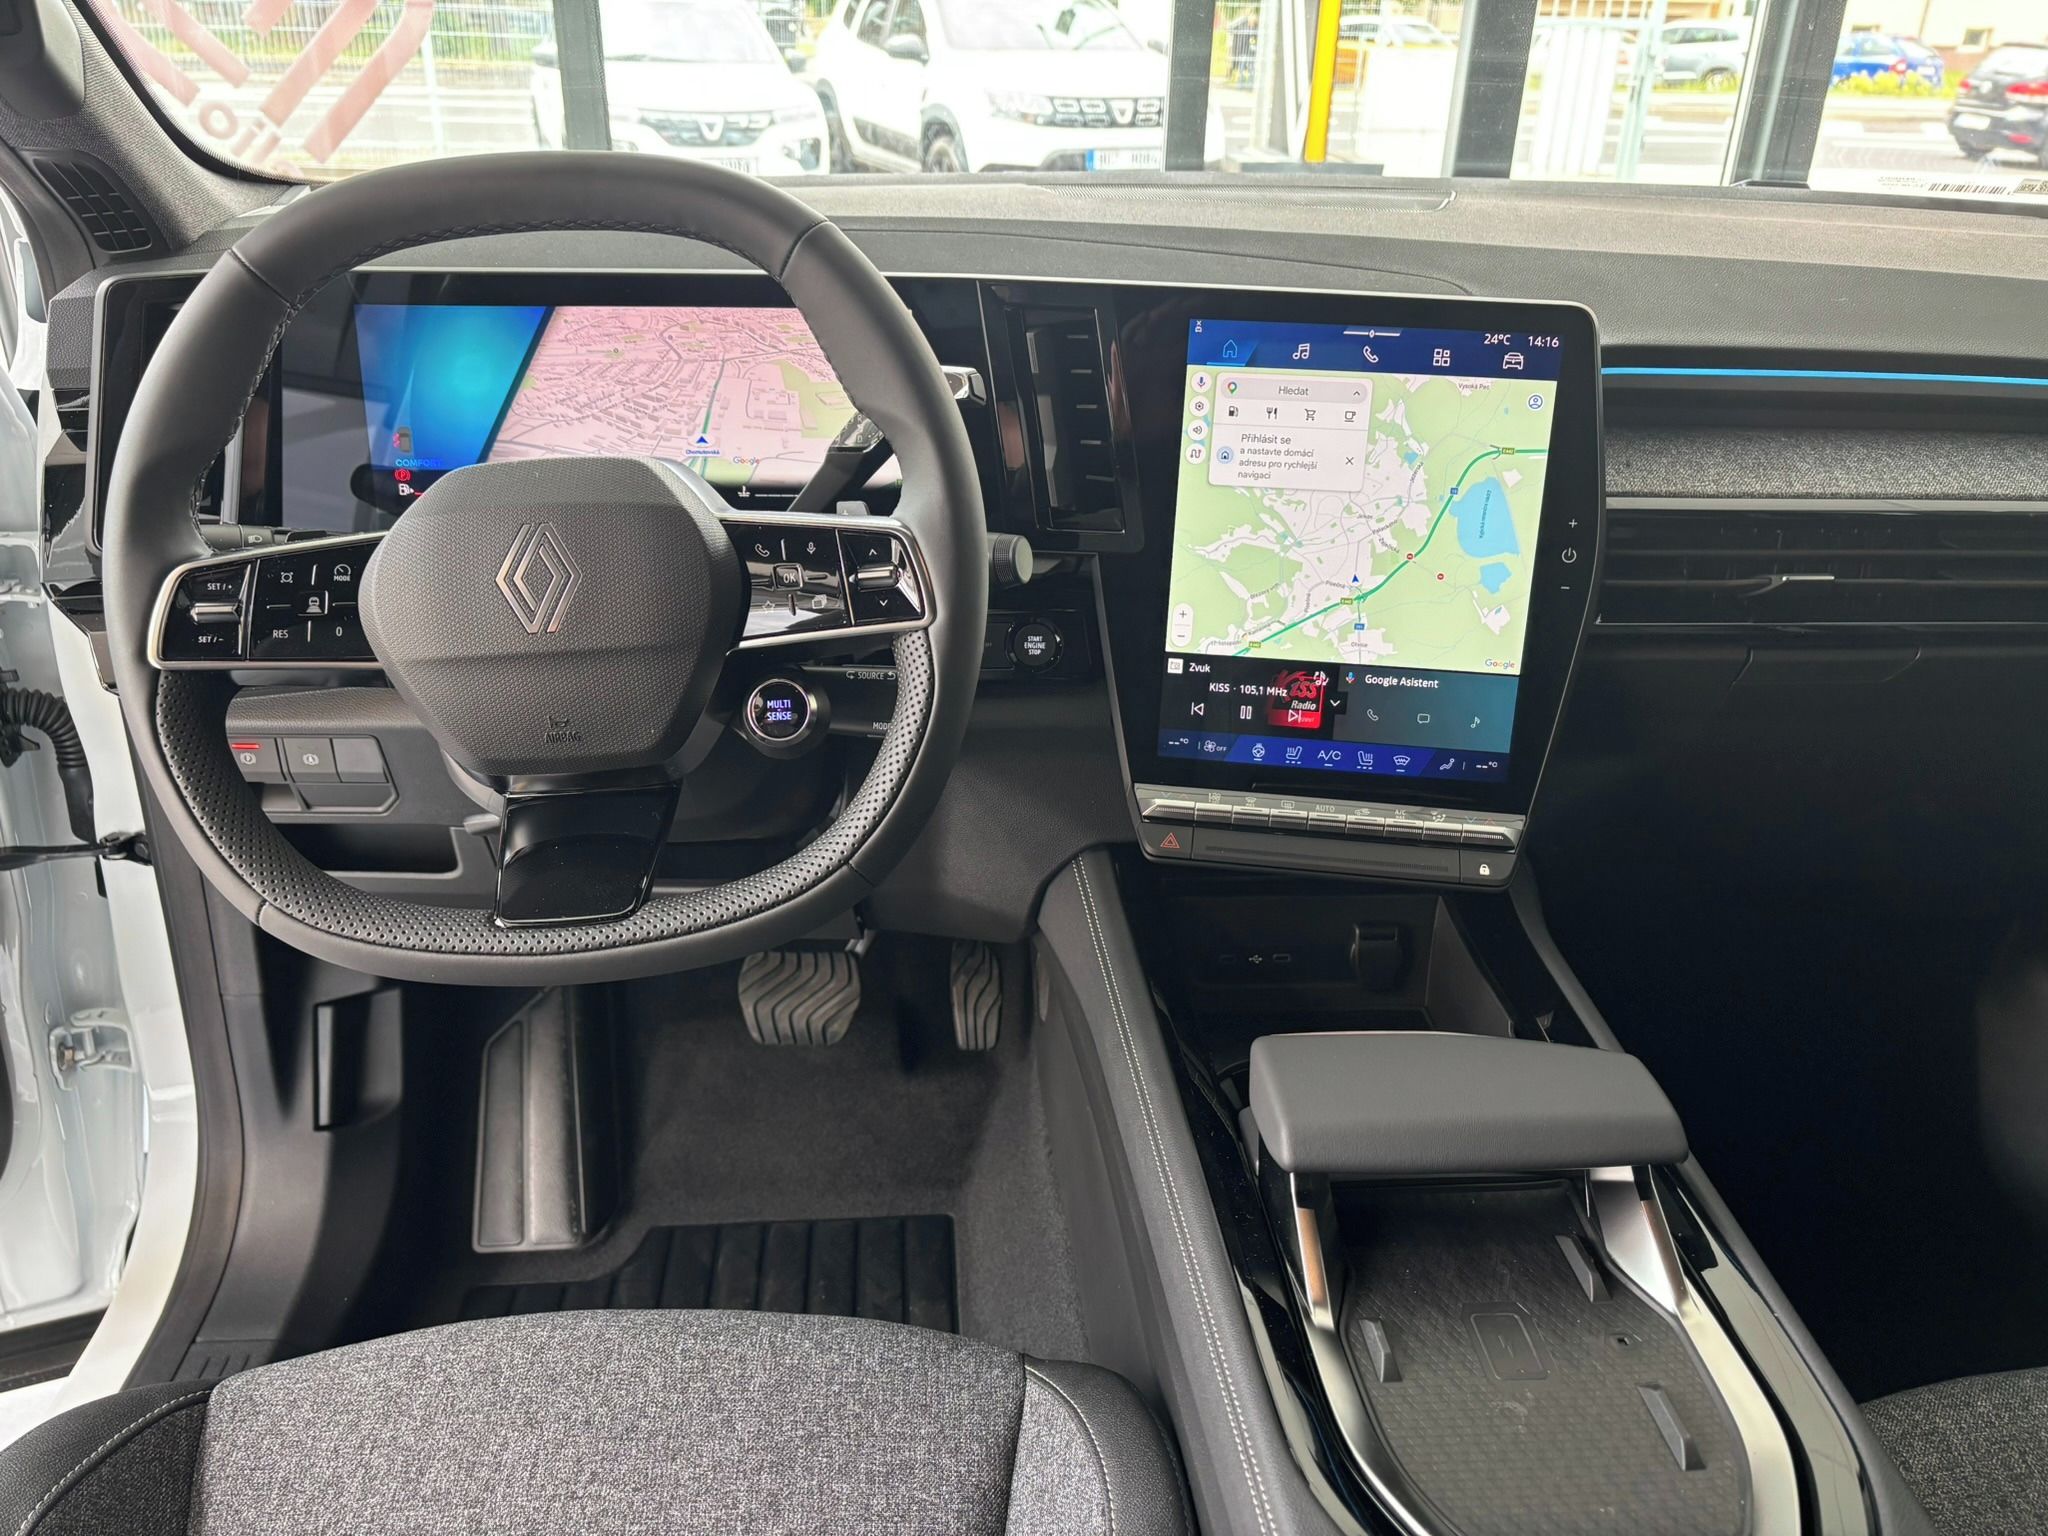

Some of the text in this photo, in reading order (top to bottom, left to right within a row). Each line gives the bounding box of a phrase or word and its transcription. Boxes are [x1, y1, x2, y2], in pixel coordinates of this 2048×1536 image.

[1528, 335, 1560, 348] 14:16
[1278, 386, 1309, 396] Hledat
[1241, 433, 1278, 444] Přihlásit
[1247, 447, 1282, 456] nastavte
[1284, 448, 1314, 458] domácí
[733, 455, 760, 466] Google
[1239, 459, 1266, 468] adresu
[1284, 461, 1318, 471] rychlejší
[1237, 471, 1271, 480] navigaci
[783, 573, 797, 583] OK
[272, 629, 289, 638] RES
[1189, 662, 1211, 673] Zvuk
[1484, 658, 1515, 669] Google
[857, 672, 885, 680] SOURCE
[1365, 674, 1439, 689] Google Asistent
[1209, 682, 1288, 697] KISS 105,1 MHz
[767, 700, 791, 709] MULTI
[1291, 700, 1317, 711] Radio
[767, 711, 792, 721] SENSE
[1317, 750, 1342, 761] A/C
[1315, 805, 1336, 813] AUTO
